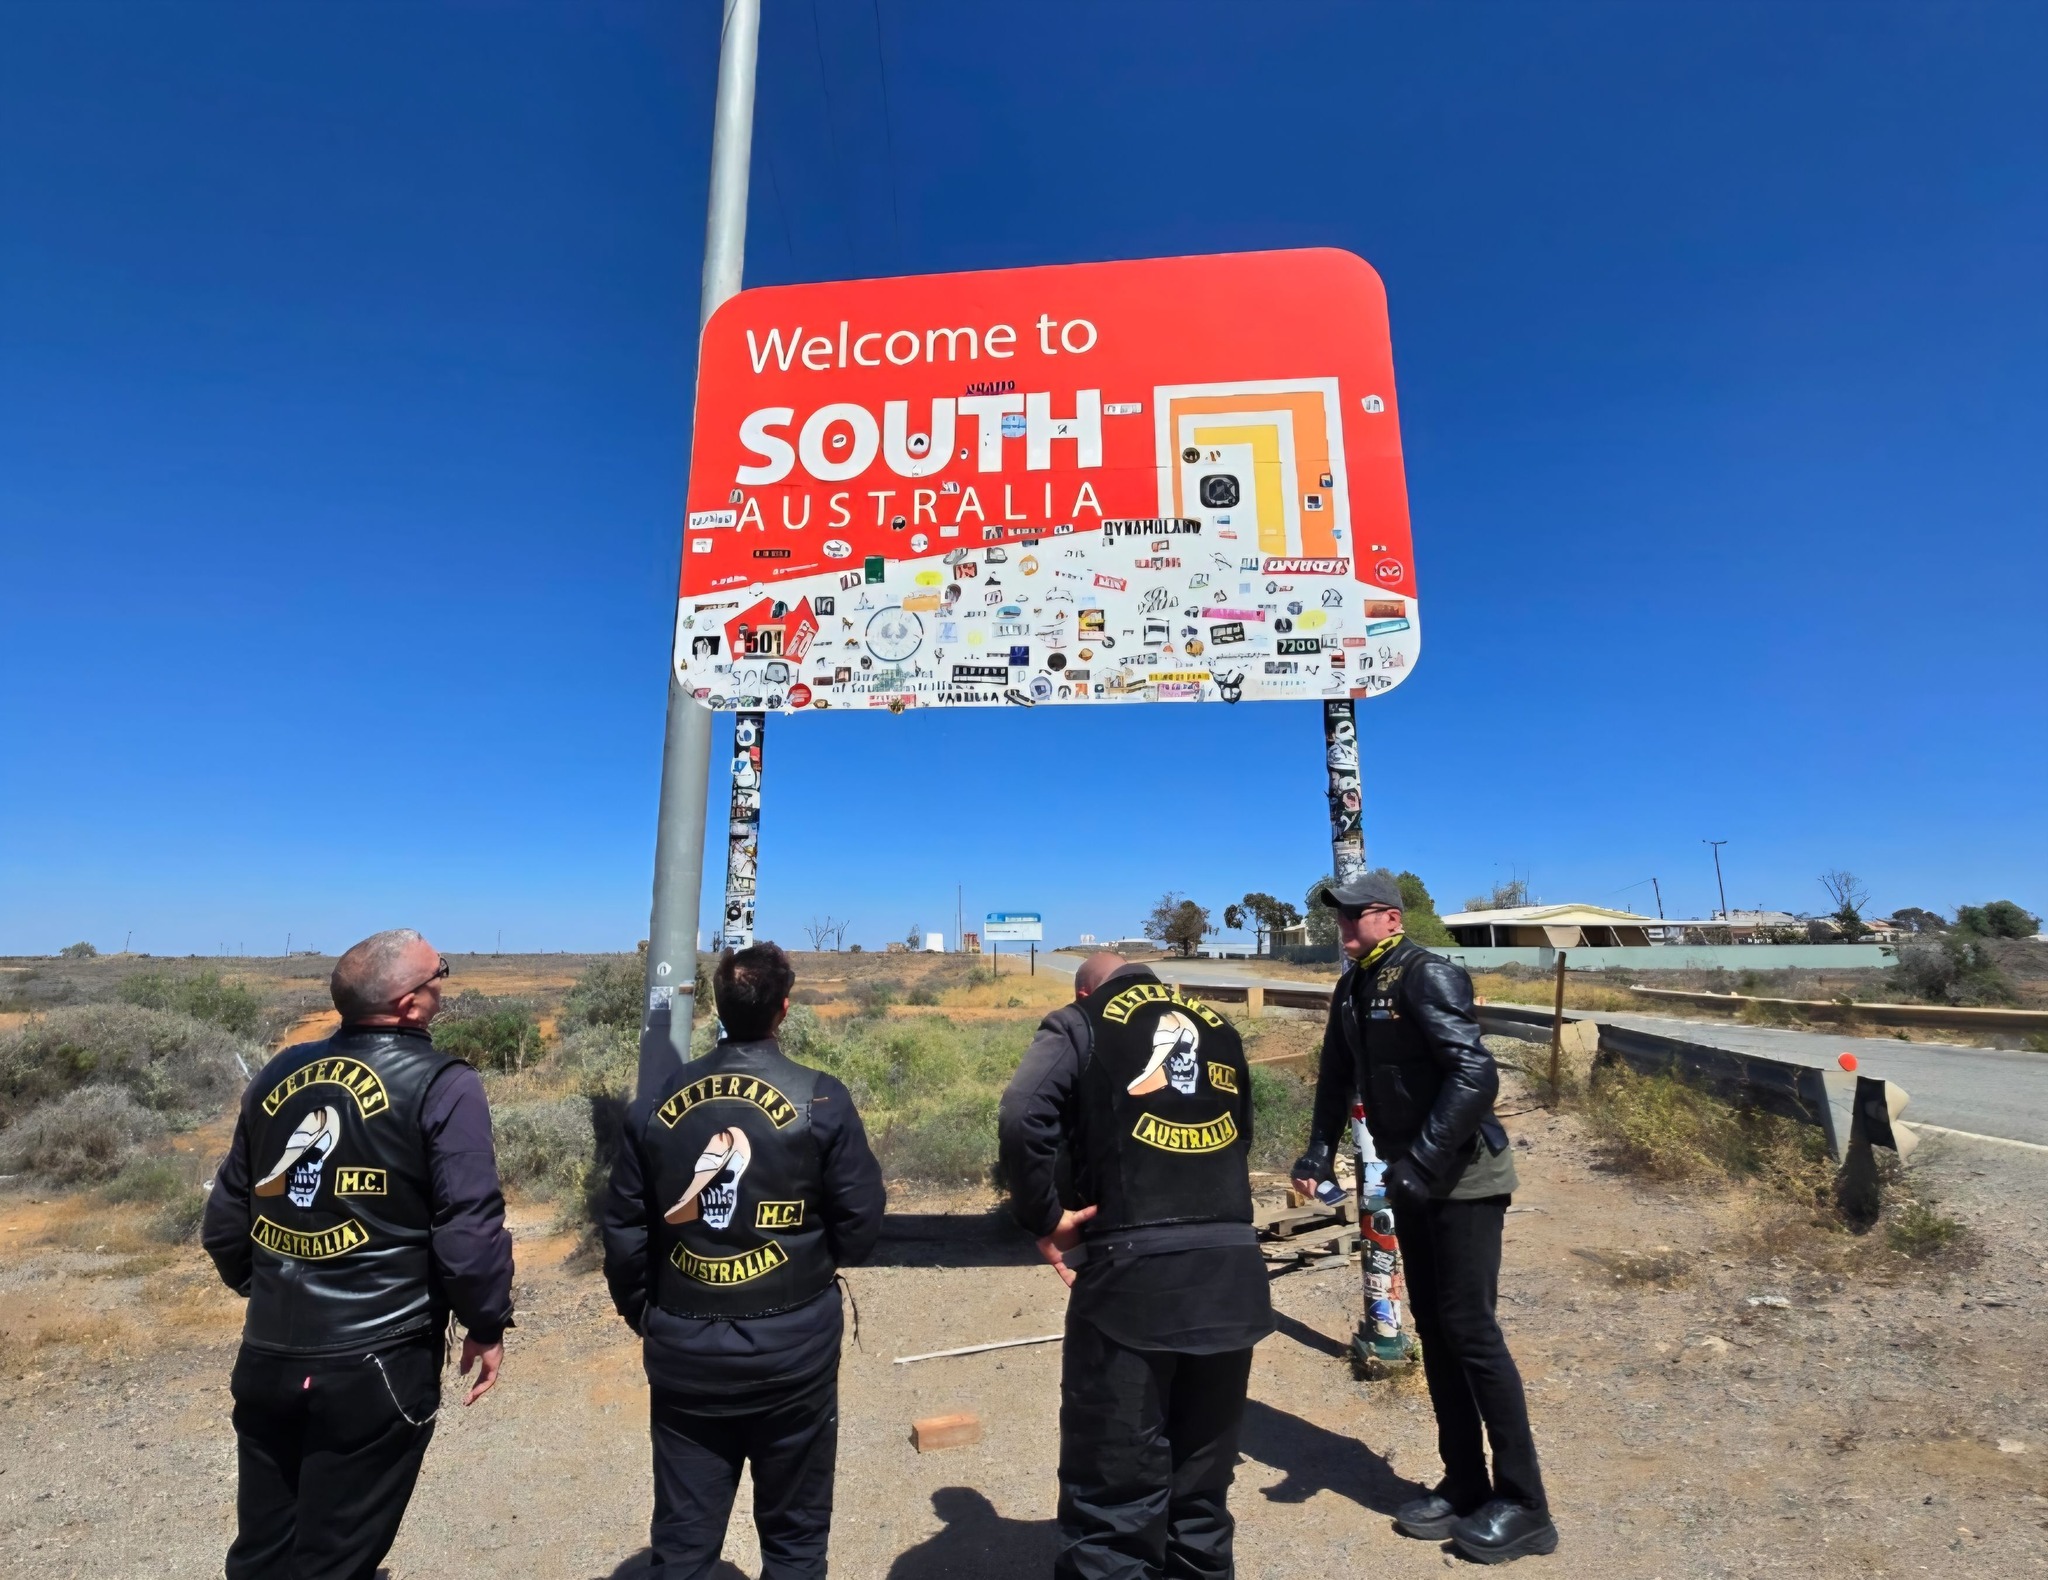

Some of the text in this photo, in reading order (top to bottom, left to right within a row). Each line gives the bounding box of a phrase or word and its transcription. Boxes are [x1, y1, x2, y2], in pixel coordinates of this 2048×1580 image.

[746, 313, 1098, 374] Welcome to
[735, 388, 1102, 486] SOUTH
[736, 481, 1102, 532] AUSTRALIA
[267, 1060, 383, 1109] VETERANS
[663, 1076, 791, 1121] VETERANS
[1143, 1117, 1232, 1149] AUSTRALIA
[341, 1171, 381, 1192] M.C.
[761, 1205, 799, 1225] M.C.
[259, 1223, 359, 1257] AUSTRALIA
[678, 1246, 779, 1283] AUSTRALIA
